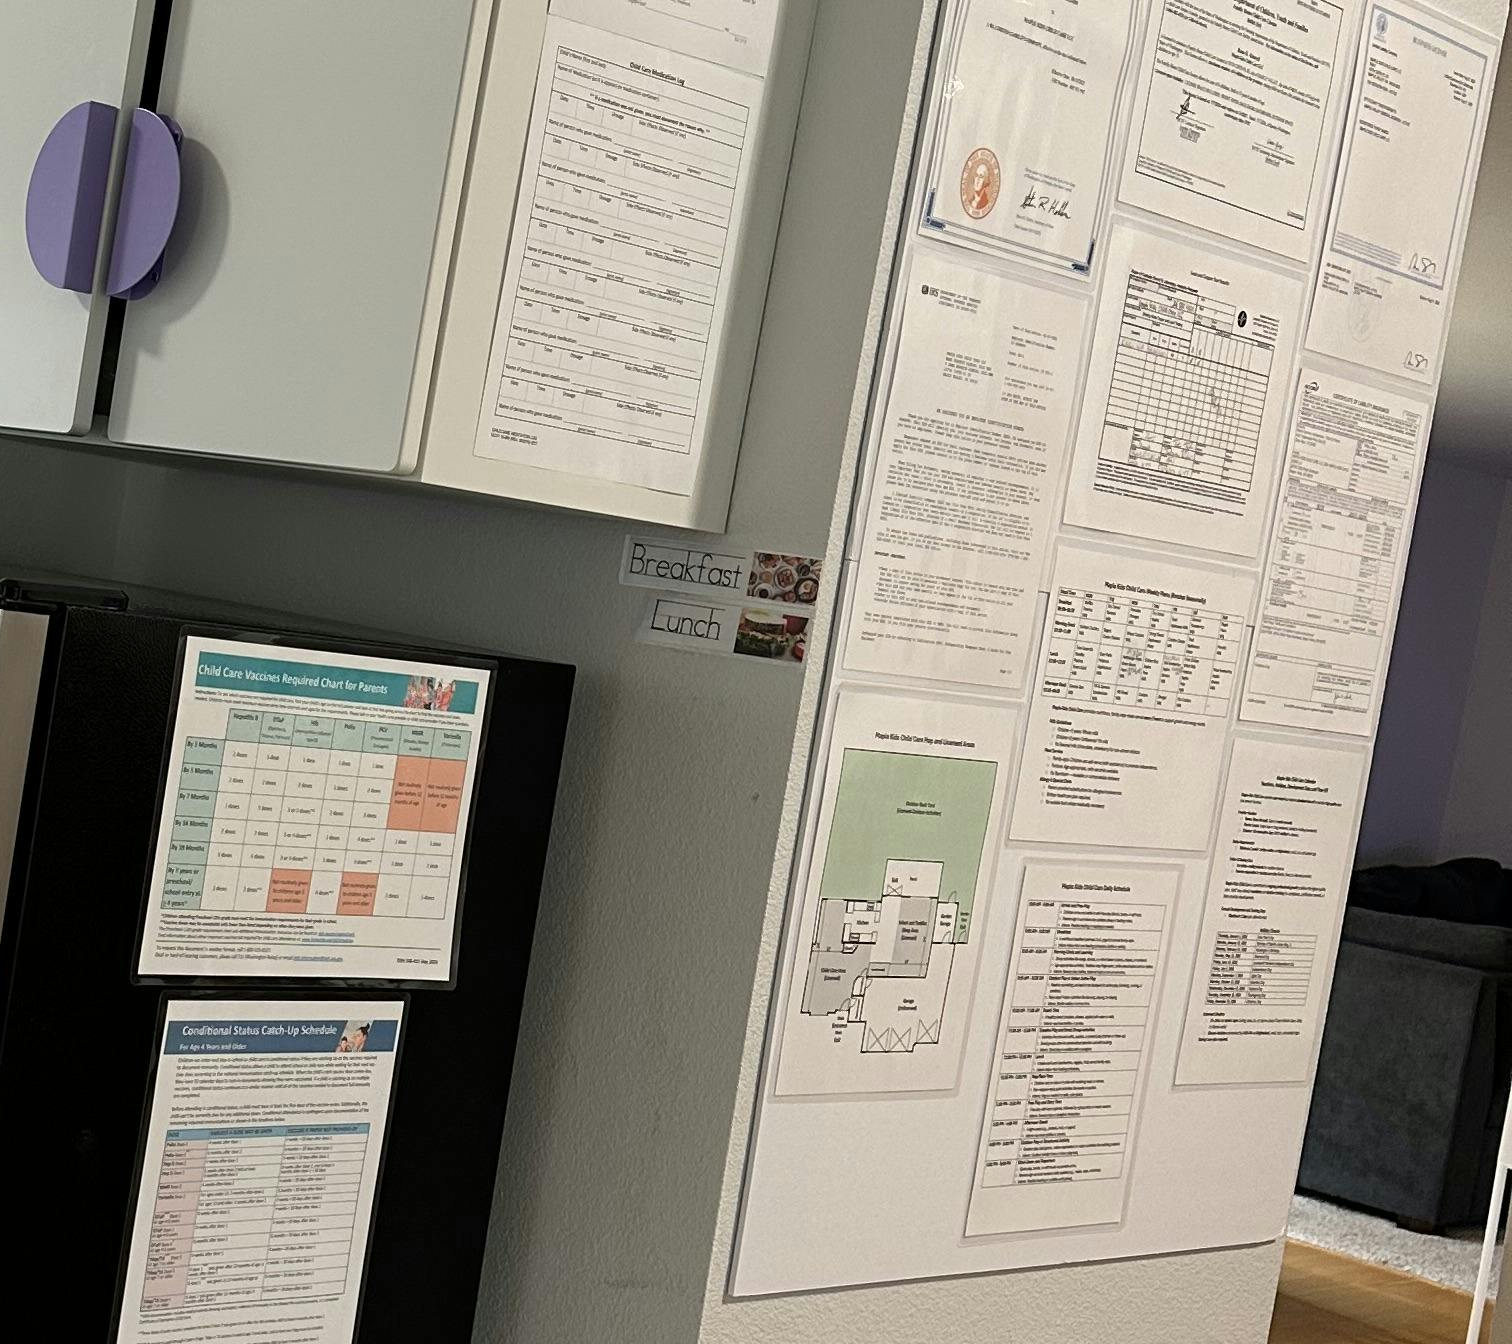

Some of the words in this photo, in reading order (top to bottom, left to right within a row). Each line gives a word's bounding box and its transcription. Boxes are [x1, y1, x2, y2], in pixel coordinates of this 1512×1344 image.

[630, 543, 743, 589] Breakfast
[650, 599, 722, 641] Lunch
[198, 663, 221, 677] Child
[223, 667, 243, 679] Care
[245, 669, 280, 683] Vaccines
[282, 672, 319, 688] Required
[321, 677, 343, 689] Chart
[344, 680, 357, 691] for
[358, 681, 389, 694] Parents
[182, 1025, 232, 1036] Conditional
[233, 1026, 260, 1036] Status
[261, 1026, 299, 1037] Catch-Up
[301, 1024, 337, 1035] Schedule
